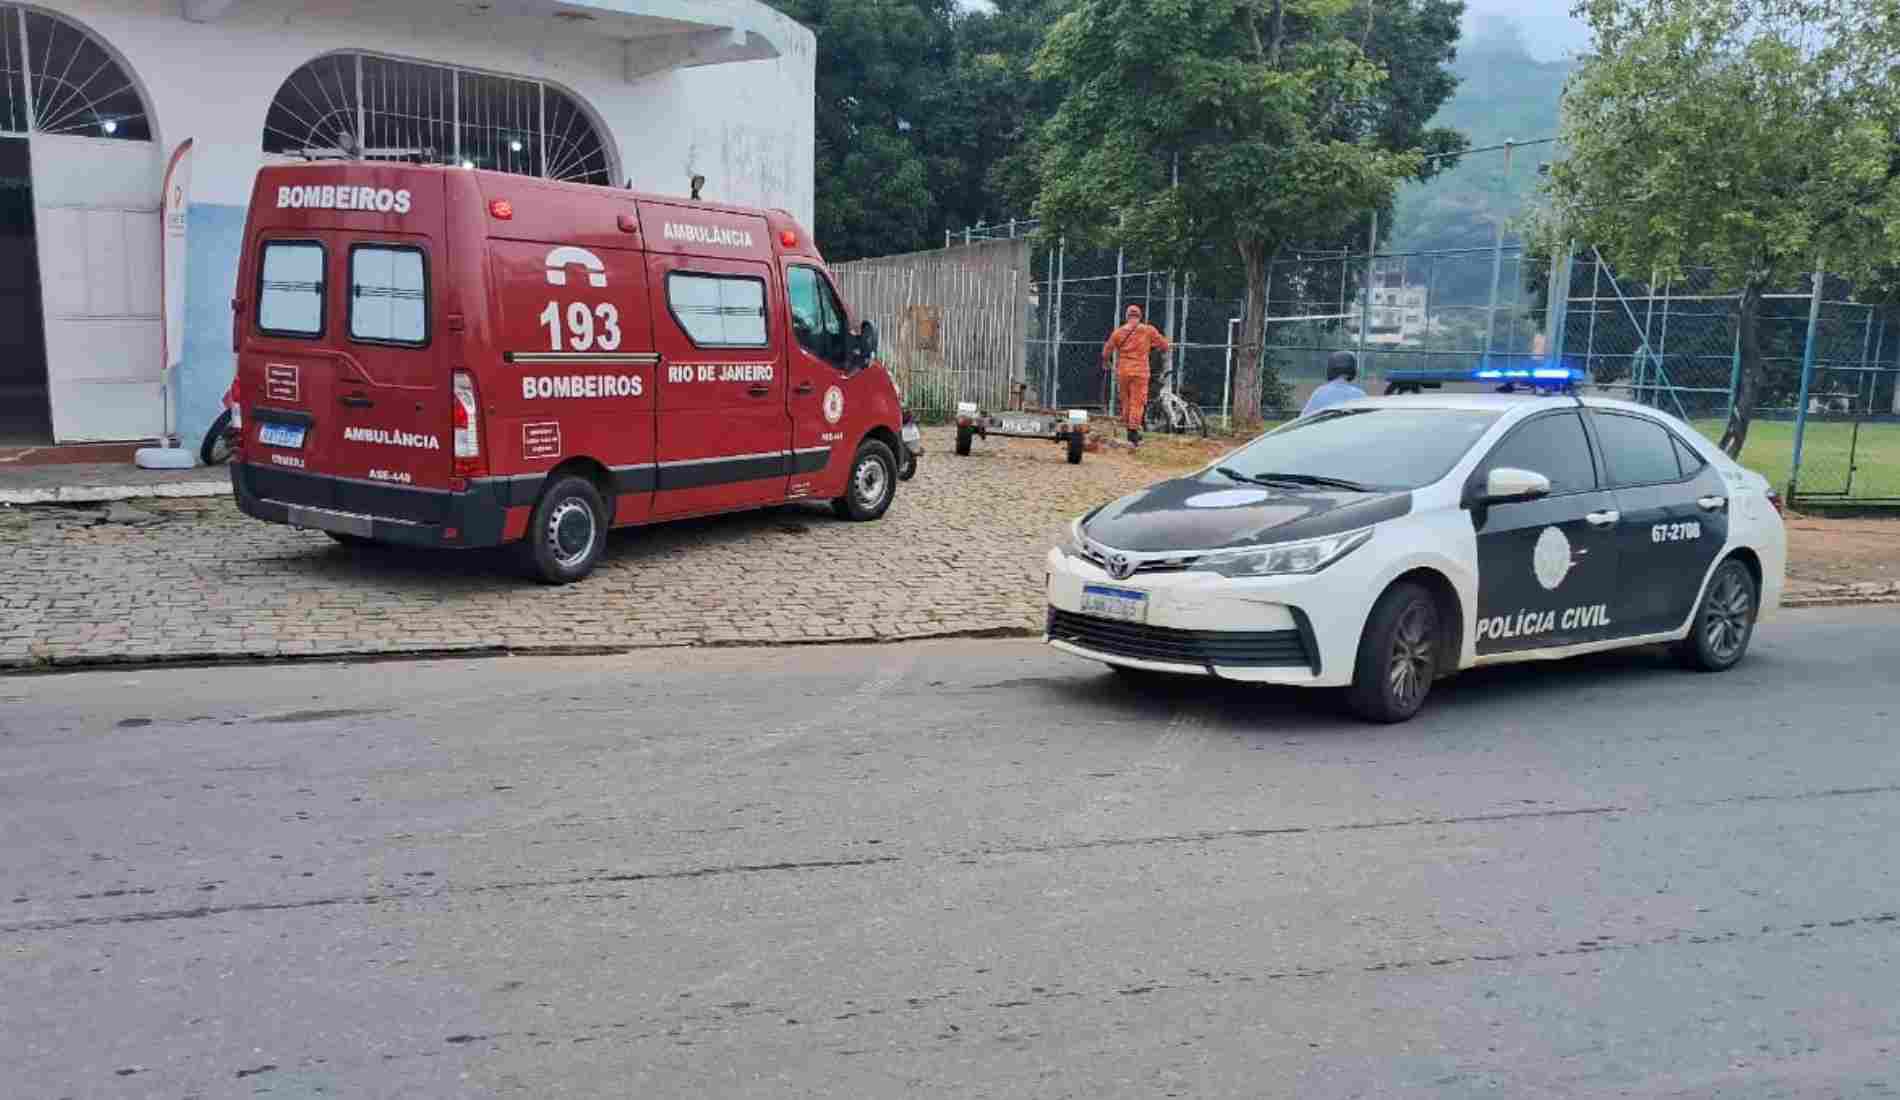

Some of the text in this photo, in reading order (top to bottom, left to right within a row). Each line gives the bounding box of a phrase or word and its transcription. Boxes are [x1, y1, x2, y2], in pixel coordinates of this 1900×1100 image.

[276, 185, 411, 213] BOMBEIROS
[540, 301, 621, 350] 193
[668, 364, 773, 383] RIO DE JANEIRO
[522, 375, 643, 399] BOMBEIROS
[343, 426, 440, 450] AMBULÂNCIA
[1475, 604, 1611, 642] POLÍCIA CIVIL
